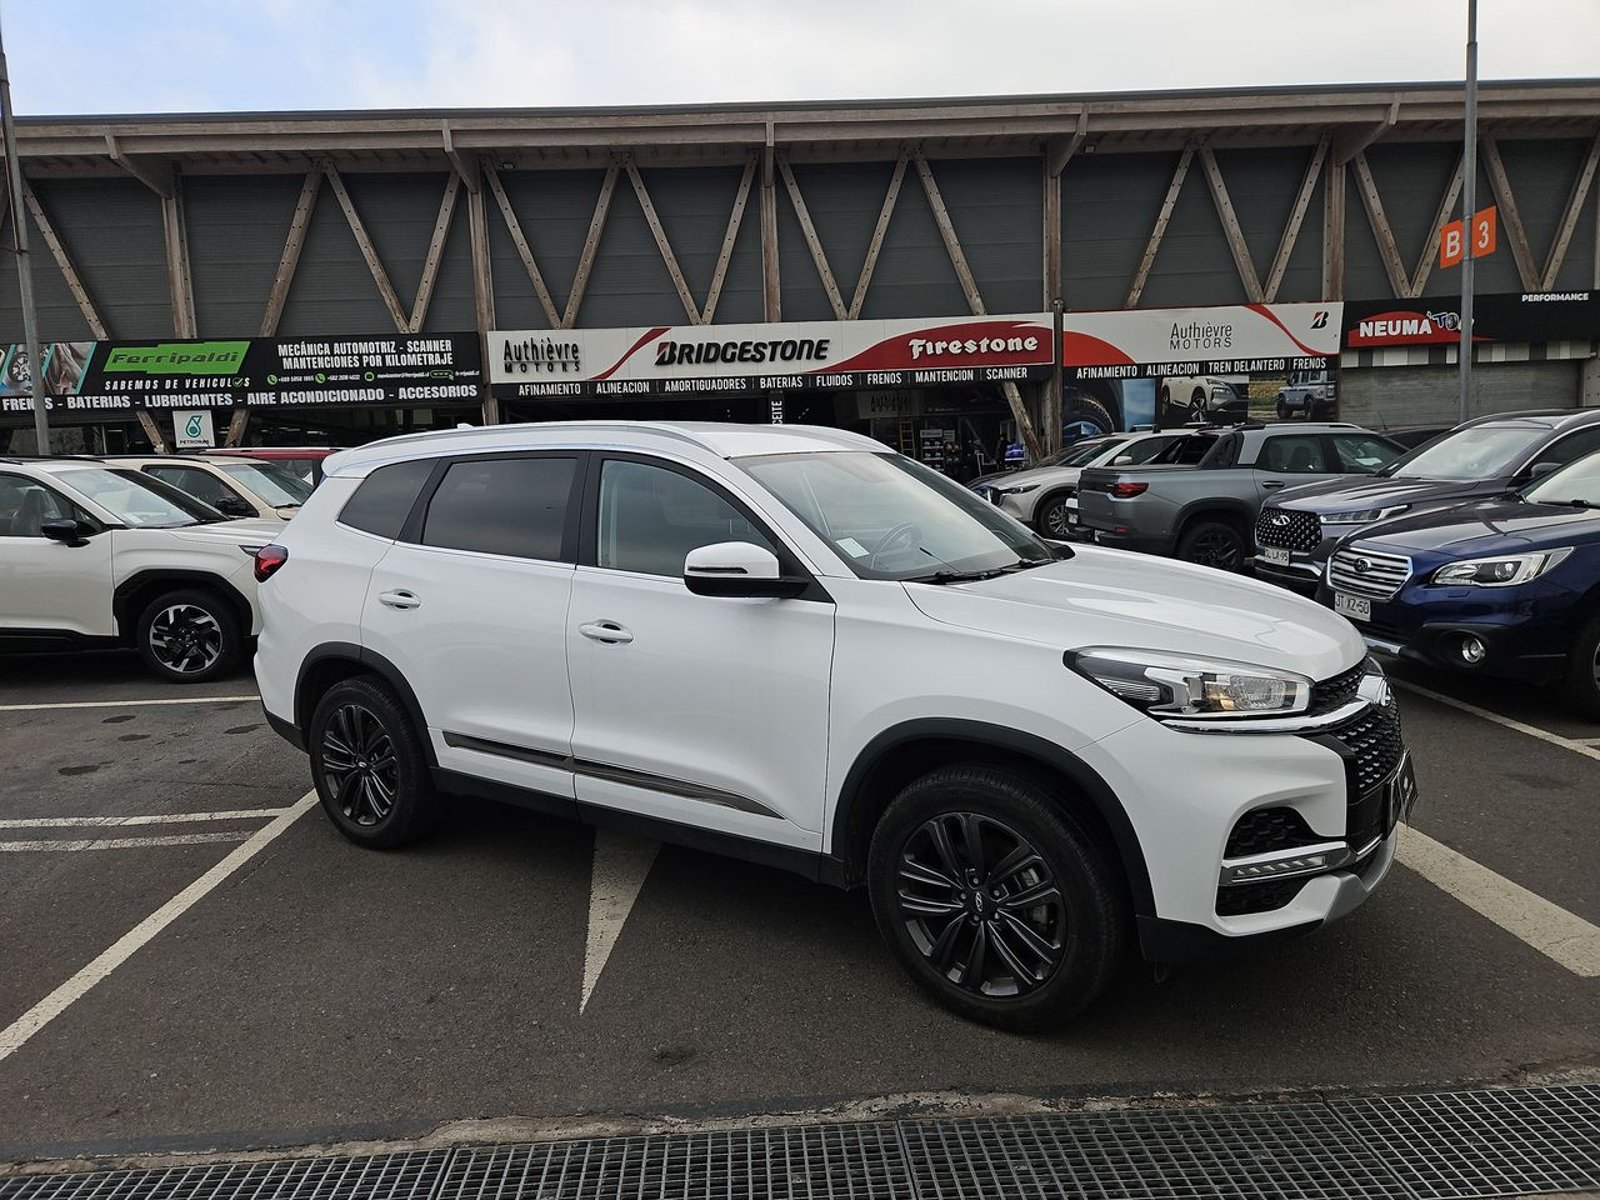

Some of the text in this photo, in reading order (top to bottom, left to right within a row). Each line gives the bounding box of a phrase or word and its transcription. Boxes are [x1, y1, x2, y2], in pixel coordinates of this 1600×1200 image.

[1446, 220, 1490, 258] B 3
[1521, 292, 1589, 302] PERFORMANCE
[1359, 318, 1433, 337] NEUMA
[277, 339, 453, 357] MECÁNICA AUTOMOTRIZ SCANNER
[503, 337, 580, 361] Authièvre
[655, 339, 831, 366] BRIDGESTONE
[908, 336, 1039, 360] Firestone
[1169, 337, 1233, 351] MOTORS
[112, 351, 240, 365] Ferripaldi
[282, 353, 454, 370] MANTENCIONES POR KILOMETRAJE
[503, 361, 581, 373] MOTORS
[1076, 357, 1327, 379] AFINAMIENTO ALINEACION TREN DELANTERO FRENOS
[105, 380, 159, 391] SABEMOS
[165, 379, 179, 390] DE
[518, 367, 1028, 396] AFINAMIENTO ALINEACION AMORTIGUADORES BATERIAS FLUIDOS FRENOS MANTENCION SCANNER
[3, 385, 478, 411] FRENS BATERIAS LUBRICANTES AIRE ACONDICIONADO ACCESORIOS
